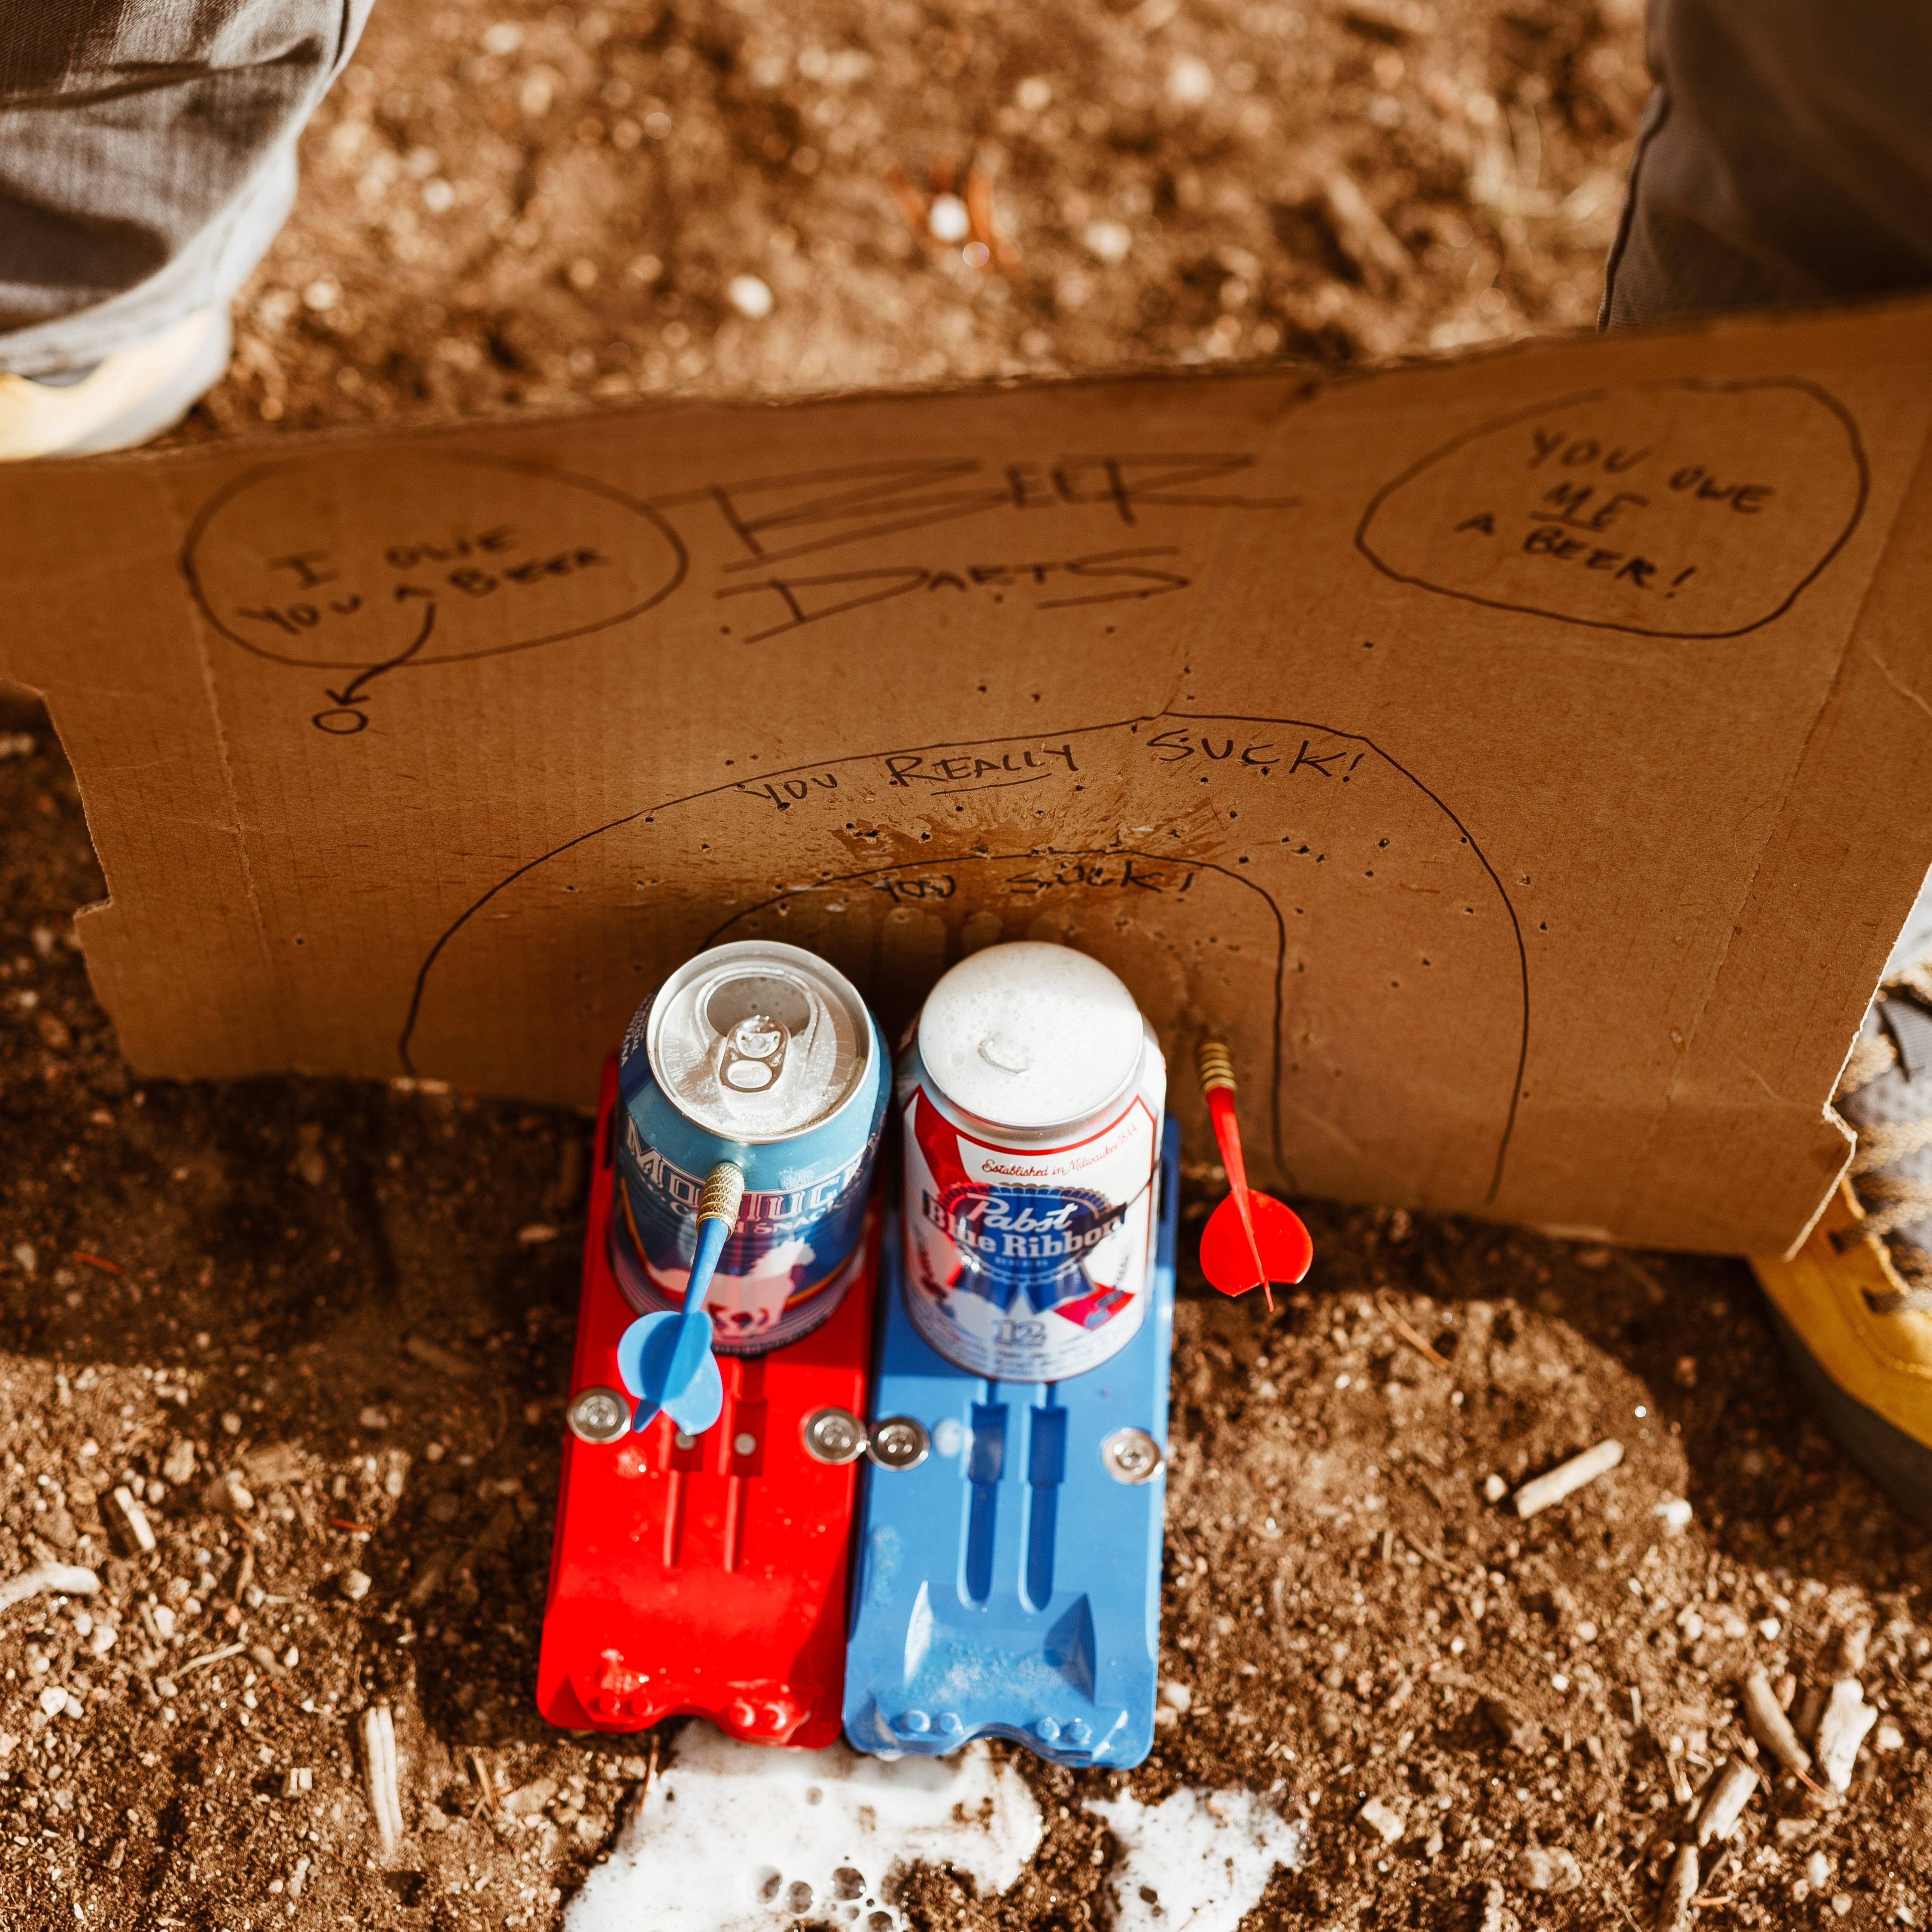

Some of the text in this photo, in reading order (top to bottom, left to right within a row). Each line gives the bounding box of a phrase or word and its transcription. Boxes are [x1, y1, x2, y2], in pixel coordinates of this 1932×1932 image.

[1528, 427, 1775, 513] YOU OWE
[678, 453, 1300, 573] BEER
[1542, 482, 1650, 529] ME
[268, 550, 339, 590] I
[1455, 513, 1697, 598] A BEER!
[236, 594, 361, 635] YOU
[714, 544, 1191, 644] DARTS
[735, 729, 1364, 809] YOU REALLY SUCK!
[859, 860, 1194, 902] YOU SUCK!
[981, 1159, 1049, 1177] Established
[1051, 1165, 1064, 1175] in
[927, 1194, 1123, 1258] Blue Ribbon
[966, 1192, 1078, 1233] Pabst
